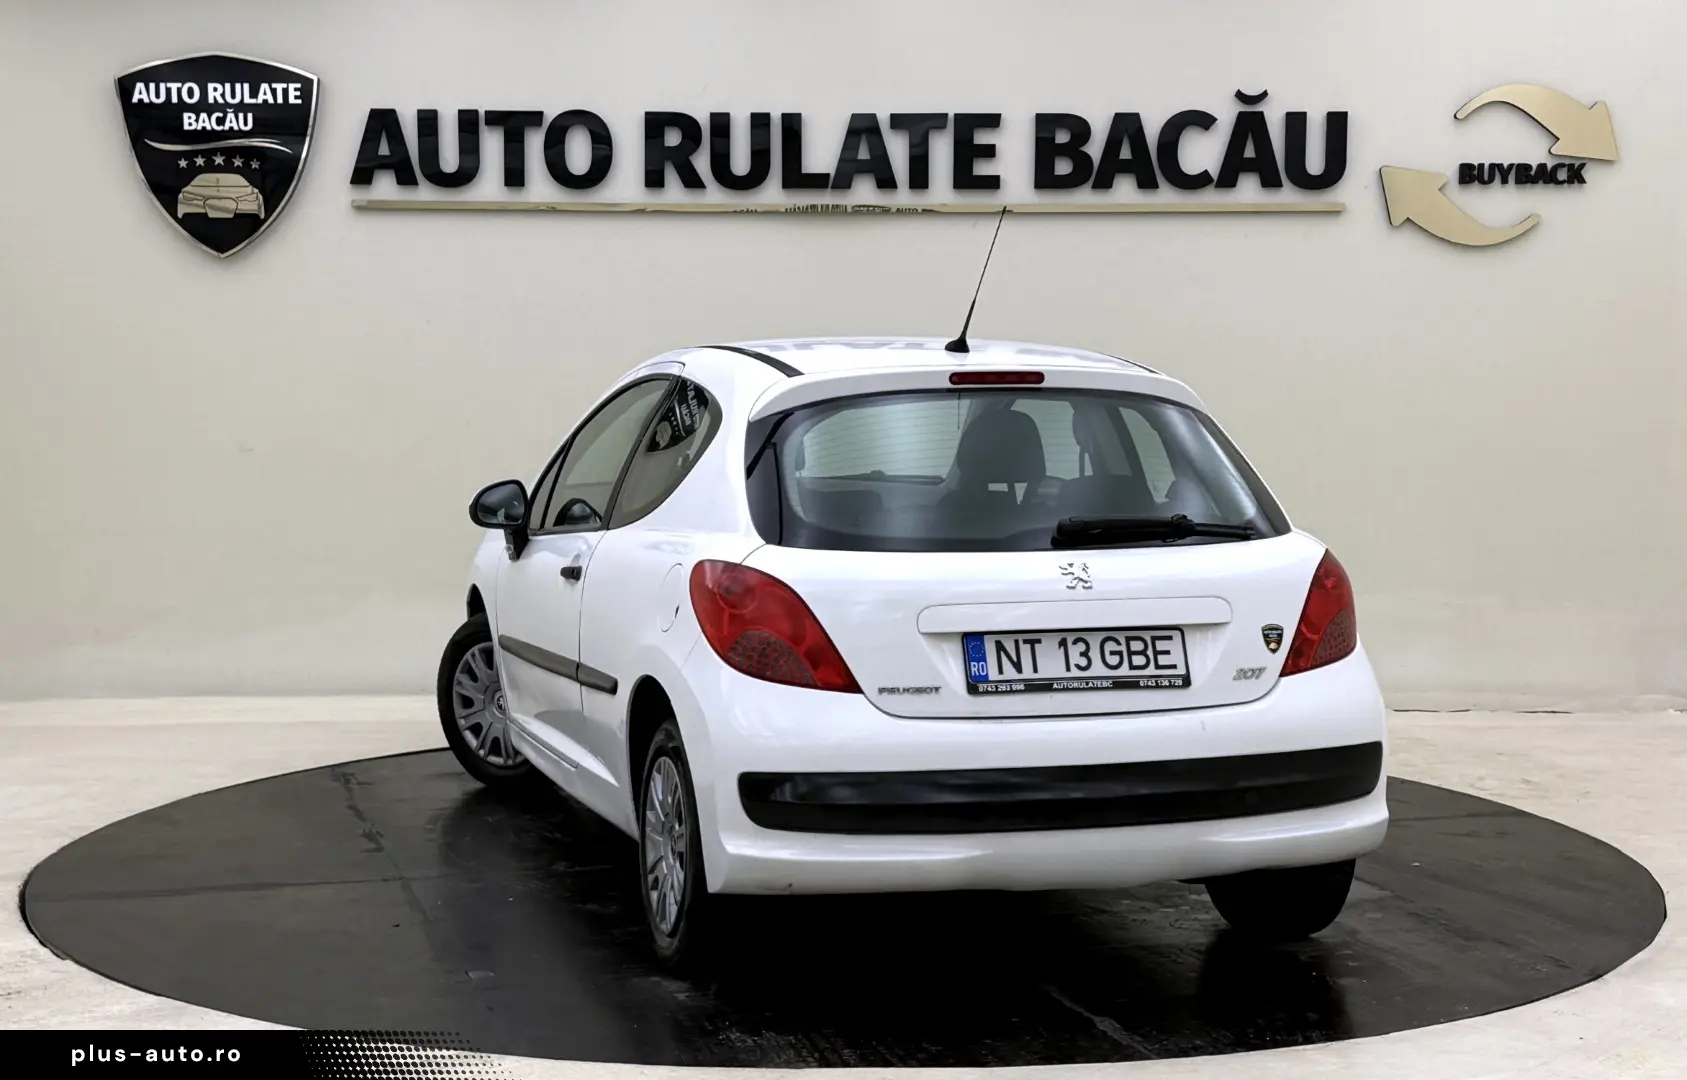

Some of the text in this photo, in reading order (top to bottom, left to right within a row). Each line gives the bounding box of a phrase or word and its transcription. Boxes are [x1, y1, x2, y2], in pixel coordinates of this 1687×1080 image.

[132, 82, 302, 104] AUTO RULATE
[183, 108, 253, 131] BACĂU
[350, 88, 1349, 190] AUTO RULATE BACĂU
[1458, 162, 1587, 185] BUYBACK
[994, 635, 1178, 675] NT 13 GBE
[970, 661, 987, 677] RO
[1232, 666, 1267, 681] 207
